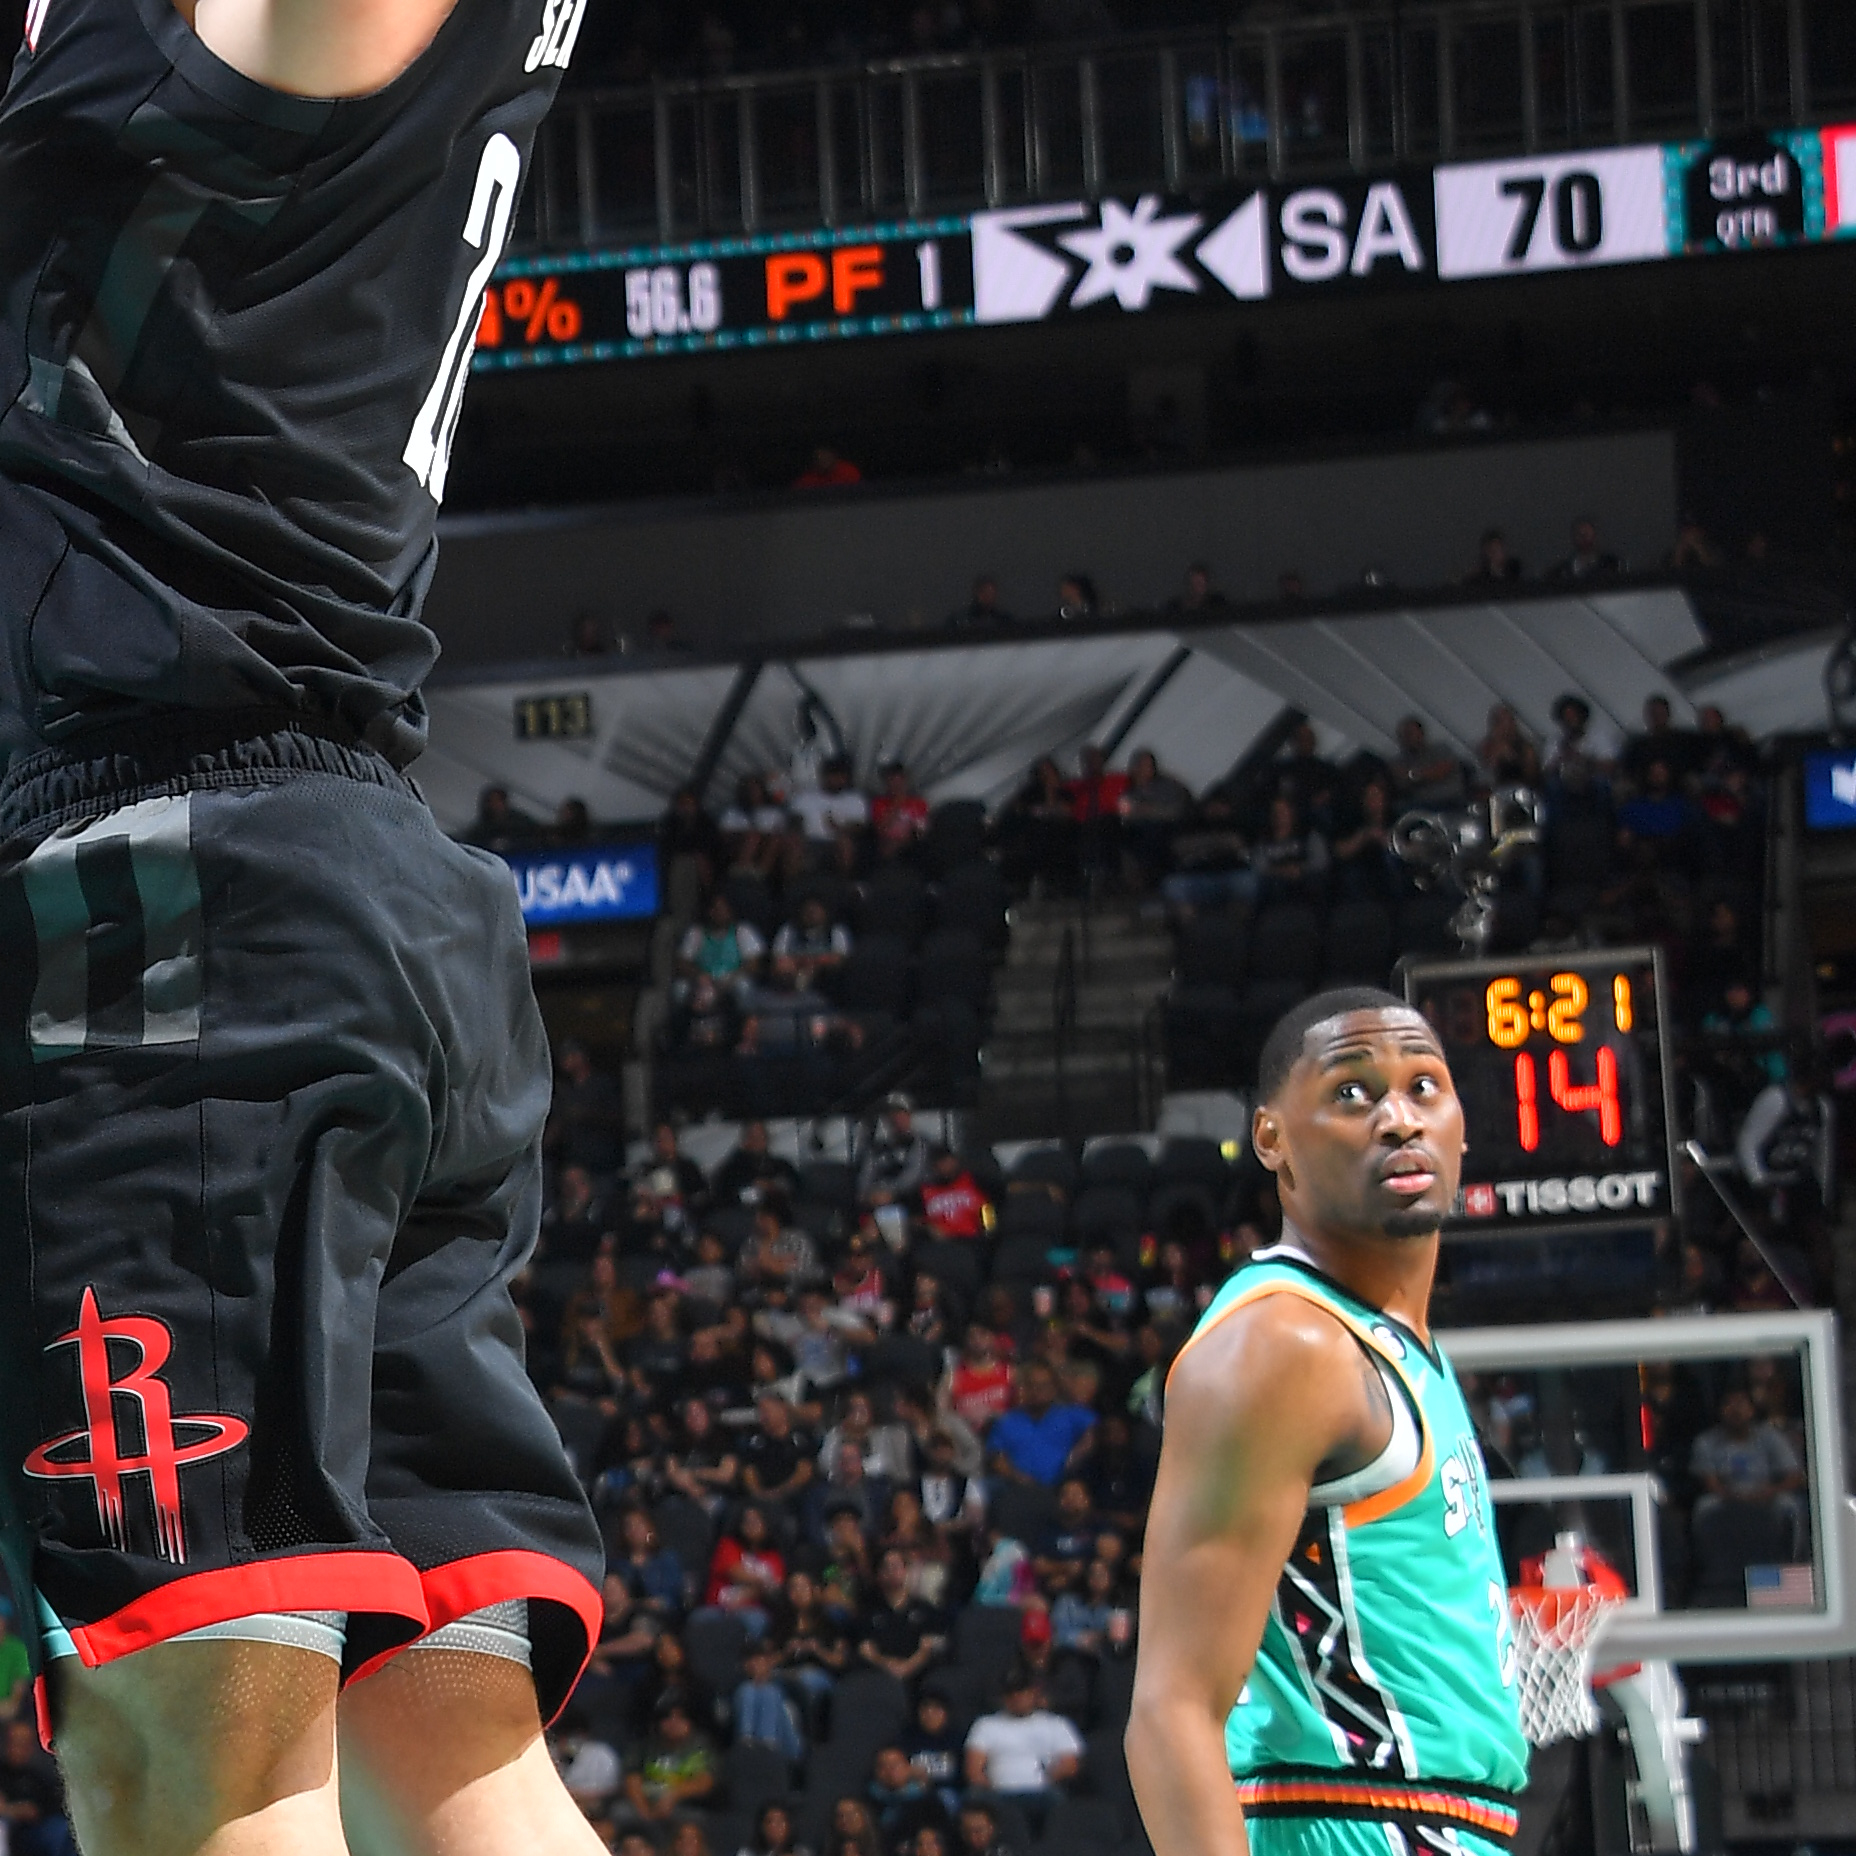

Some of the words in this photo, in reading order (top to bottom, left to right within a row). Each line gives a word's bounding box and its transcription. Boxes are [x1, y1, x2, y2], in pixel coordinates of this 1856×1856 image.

[1708, 153, 1788, 200] 3rd
[1279, 183, 1424, 280] SA
[1498, 171, 1606, 266] 70
[624, 260, 722, 338] 56.6
[764, 245, 885, 321] PF
[1486, 971, 1634, 1049] 6:21
[1515, 1045, 1622, 1153] 14
[1495, 1171, 1660, 1216] TISSOT
